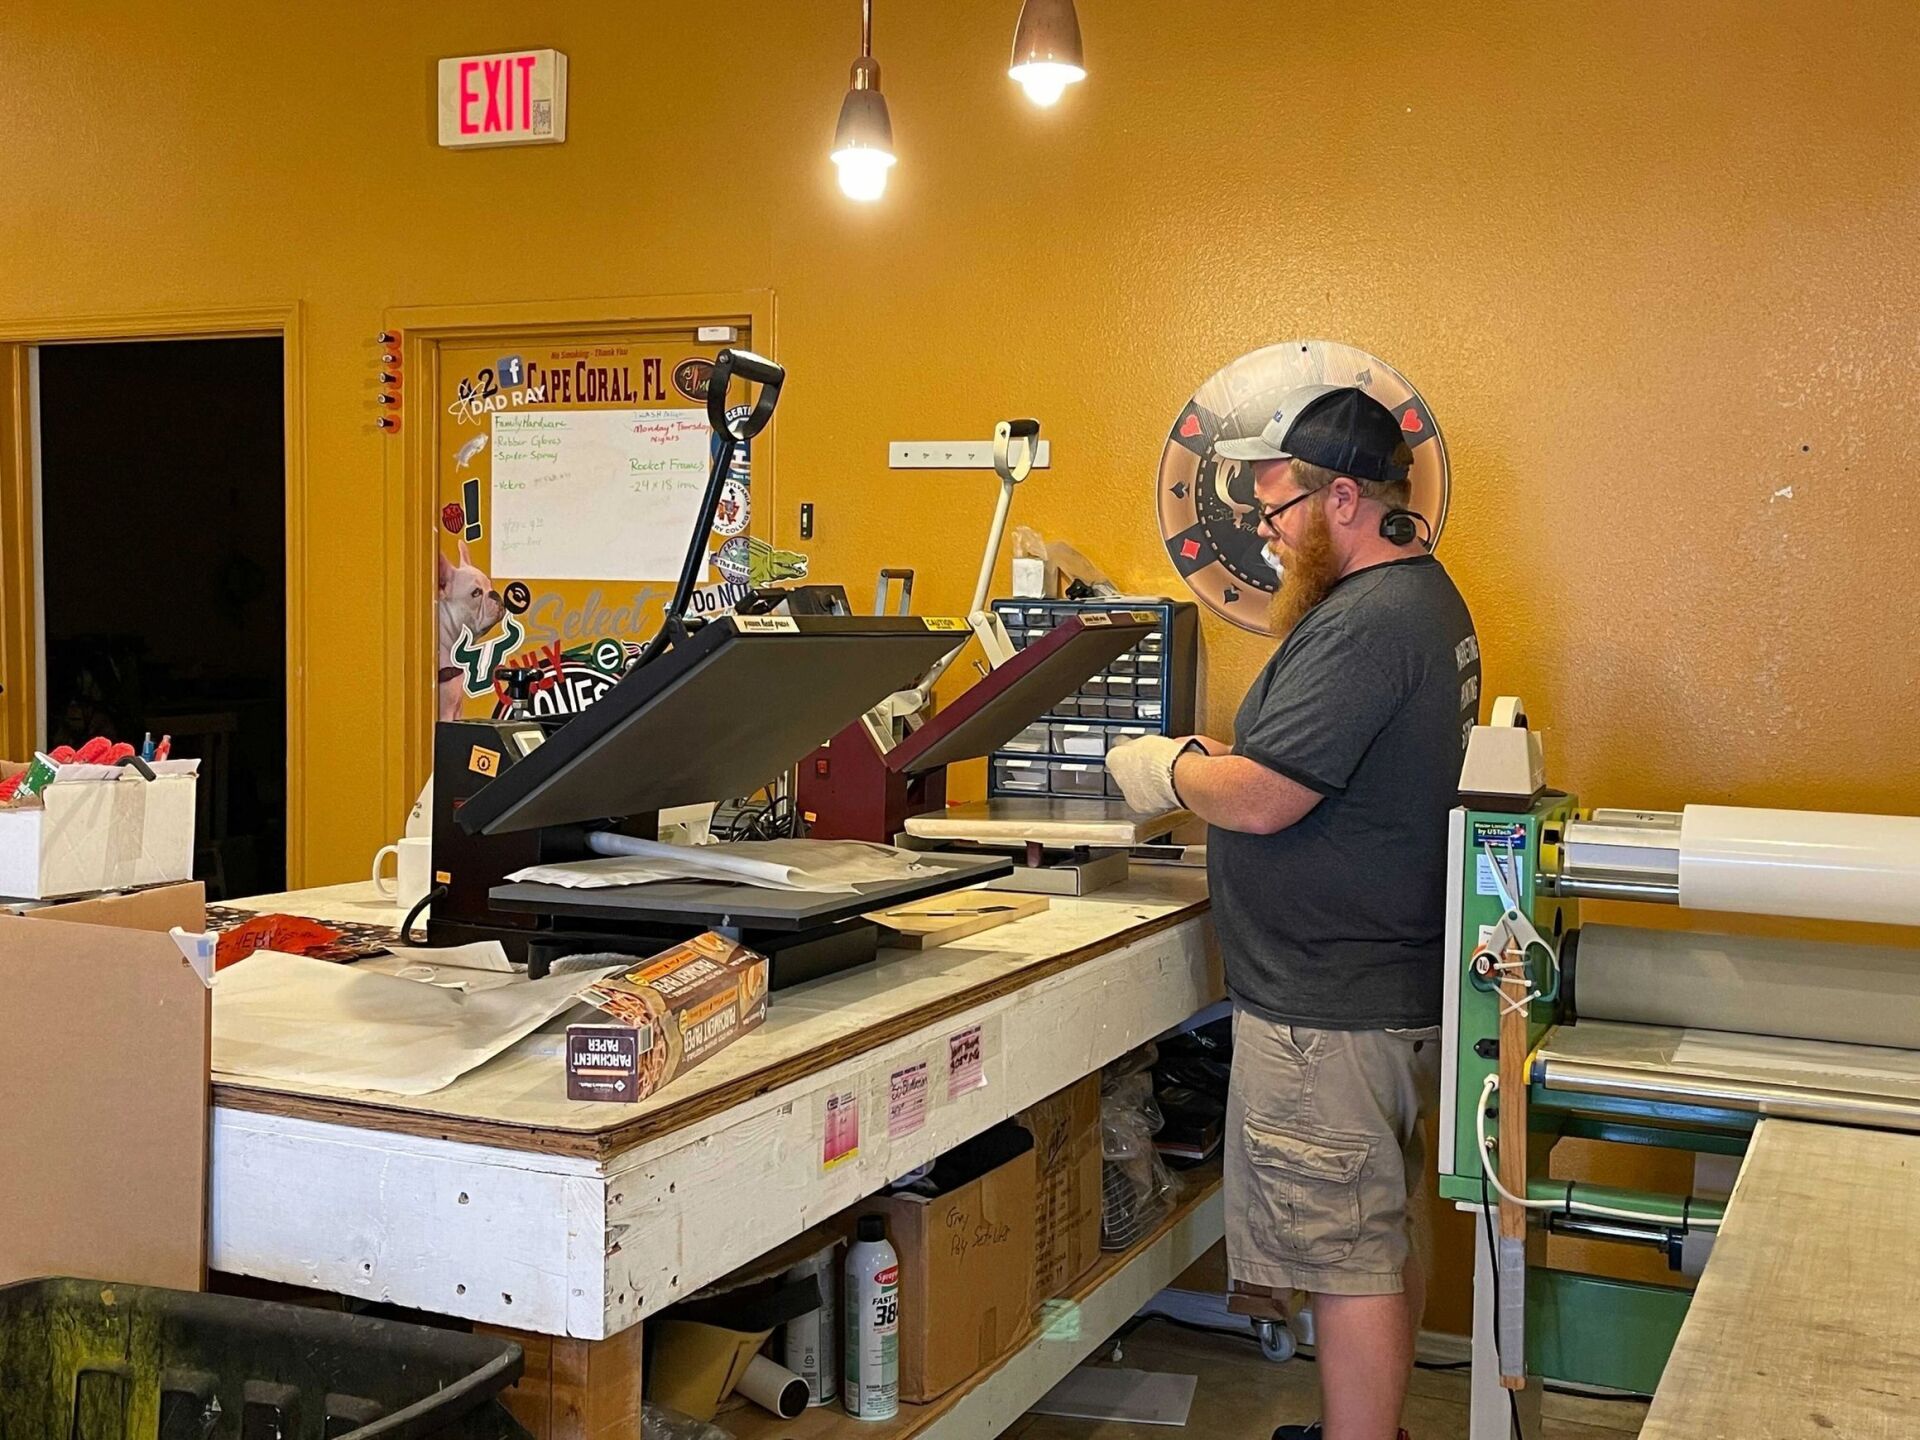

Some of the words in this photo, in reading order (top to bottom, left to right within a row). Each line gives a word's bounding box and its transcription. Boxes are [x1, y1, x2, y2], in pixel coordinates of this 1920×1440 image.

[460, 56, 536, 135] EXIT
[526, 362, 571, 403] CAPE
[575, 360, 637, 404] CORAL,
[643, 358, 666, 401] FL
[511, 385, 545, 407] RAY
[495, 415, 523, 433] Family
[522, 414, 567, 429] Hardware
[633, 424, 669, 436] Monday
[531, 435, 561, 448] Gloves
[530, 451, 558, 464] Spray
[629, 457, 666, 471] Rocket
[692, 589, 716, 613] Do
[524, 587, 671, 648] Select
[588, 1038, 619, 1052] PAPER
[573, 1052, 632, 1067] PARCHMENT
[872, 1295, 892, 1305] FAST
[874, 1302, 898, 1327] 38
